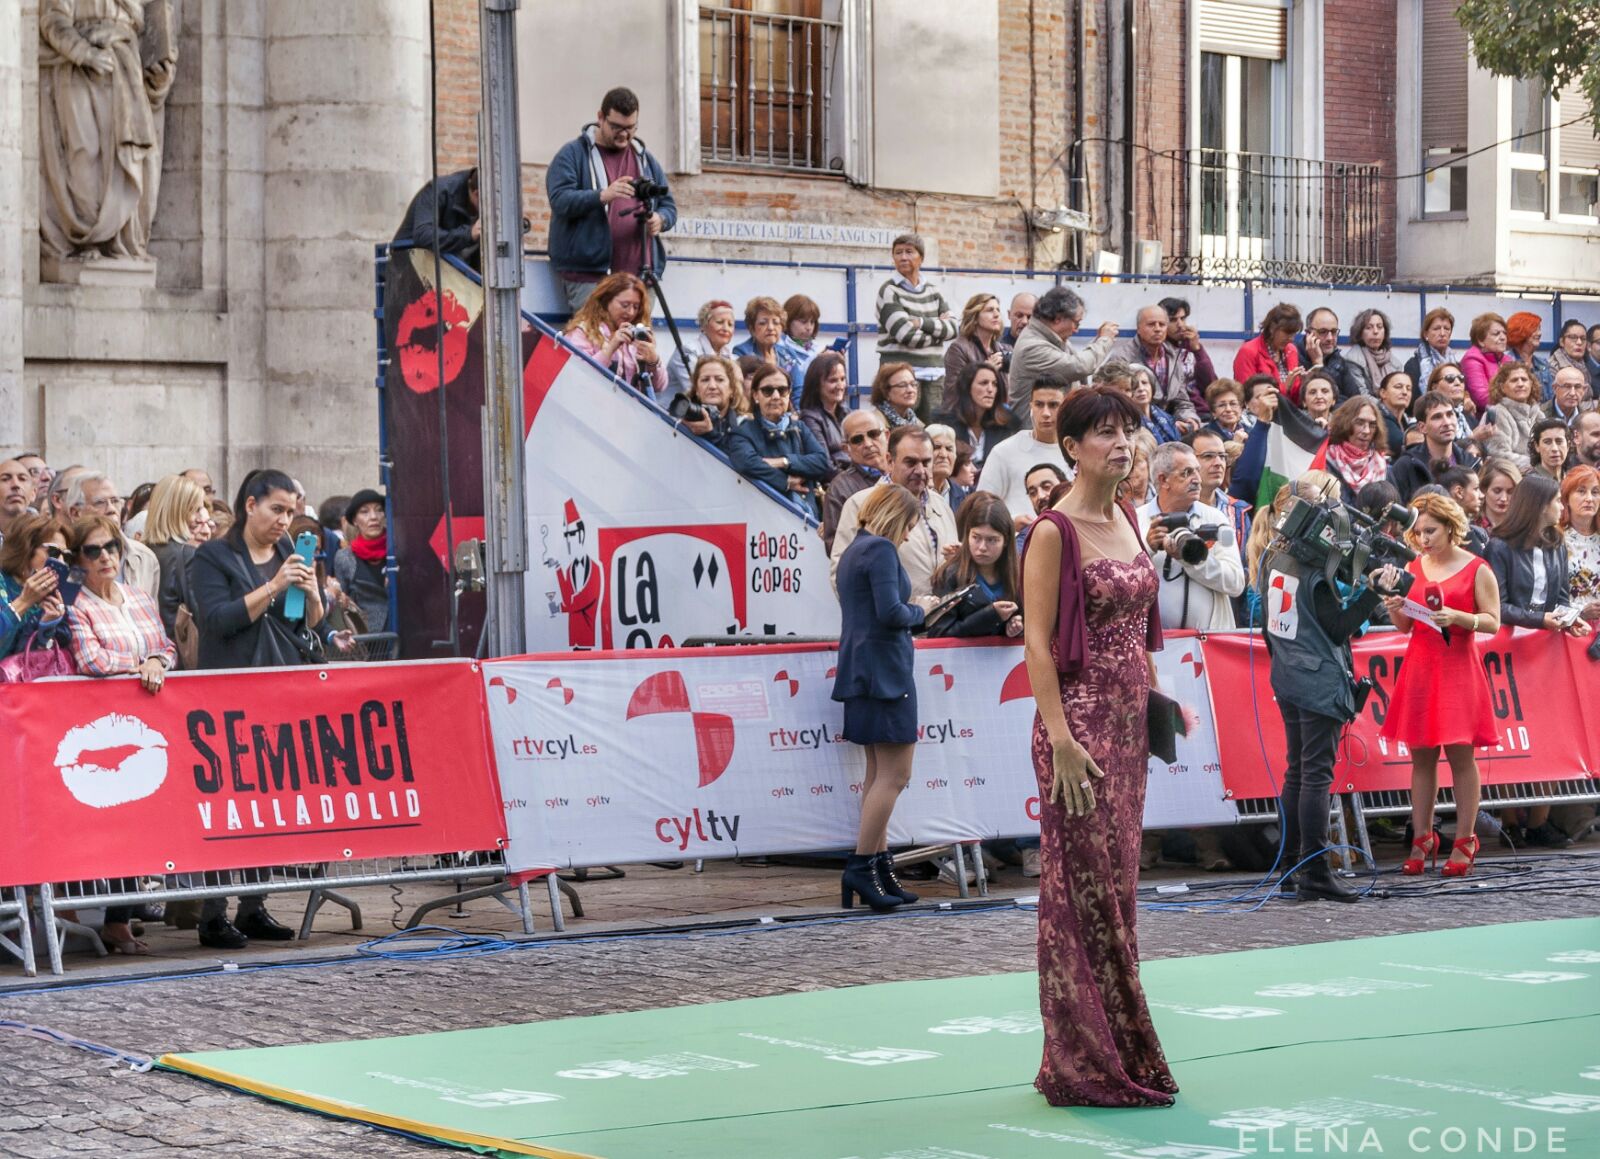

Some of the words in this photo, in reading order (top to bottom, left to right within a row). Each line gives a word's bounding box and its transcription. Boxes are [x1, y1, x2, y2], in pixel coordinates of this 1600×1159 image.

[695, 221, 783, 238] PENITENCIAL
[789, 225, 804, 240] DE
[810, 226, 833, 242] LAS
[839, 227, 897, 244] ANGUSTI
[769, 723, 848, 749] rtvcyl.e
[916, 719, 974, 743] vcyl.es
[186, 700, 415, 794] SEMINCI
[512, 734, 598, 760] rtvcyl.es
[849, 782, 864, 794] cyl
[198, 789, 421, 830] VALLADOLID
[655, 808, 740, 851] cyltv
